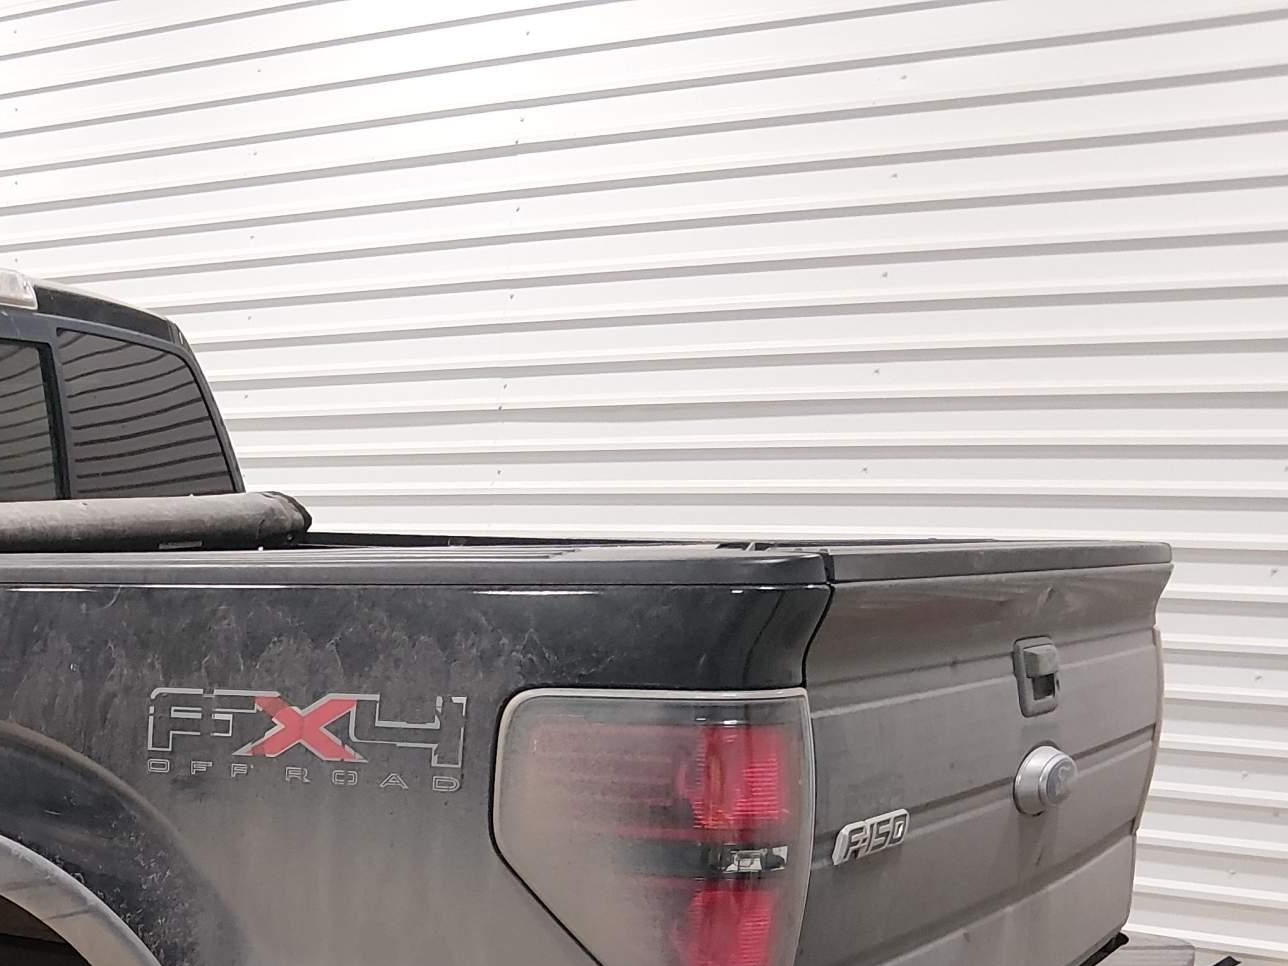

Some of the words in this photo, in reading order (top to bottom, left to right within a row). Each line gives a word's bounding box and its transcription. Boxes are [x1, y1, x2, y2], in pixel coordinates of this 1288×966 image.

[147, 687, 467, 768] FX4
[147, 758, 250, 778] OFF
[284, 766, 461, 792] ROAD
